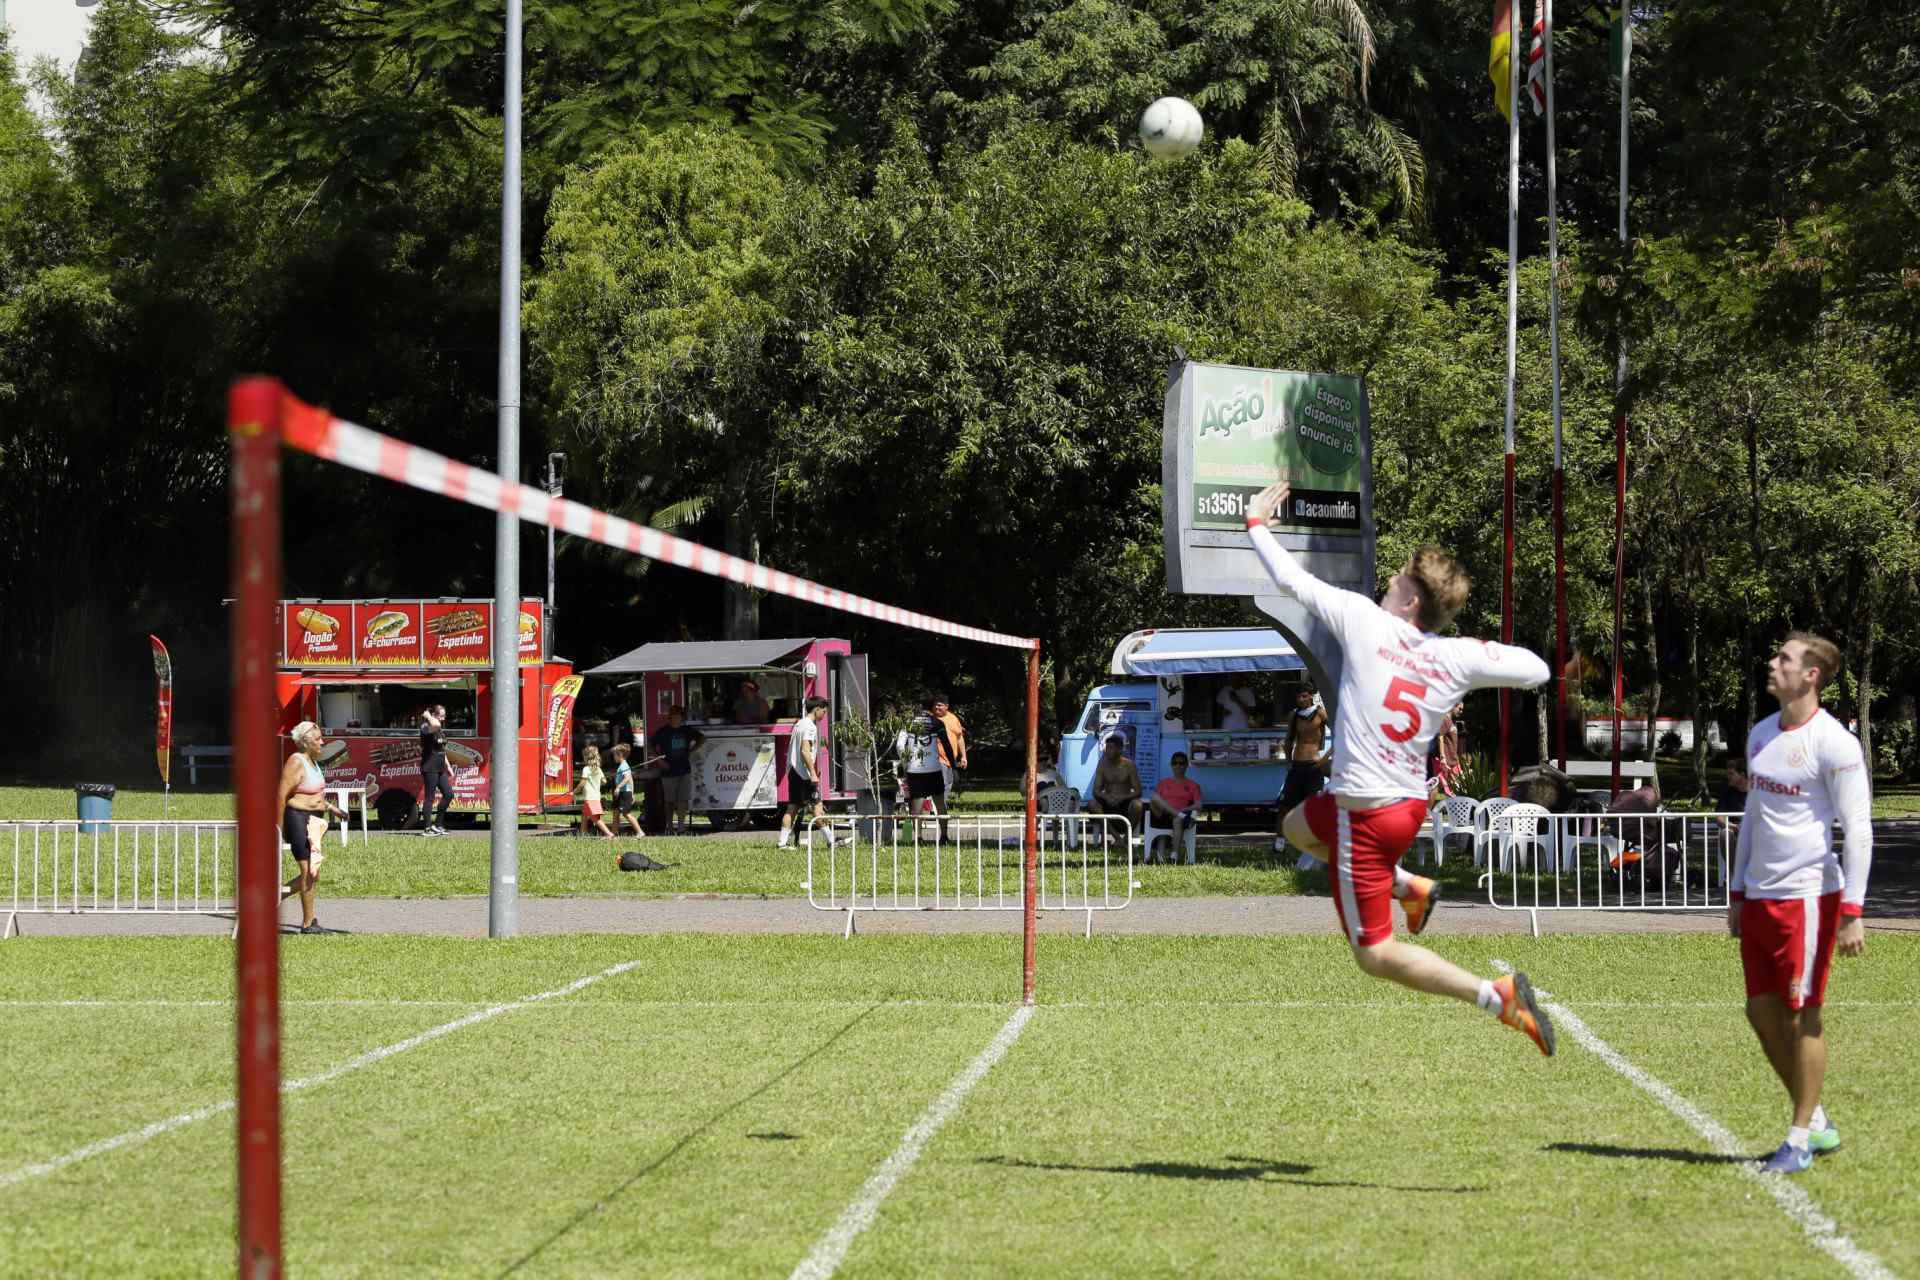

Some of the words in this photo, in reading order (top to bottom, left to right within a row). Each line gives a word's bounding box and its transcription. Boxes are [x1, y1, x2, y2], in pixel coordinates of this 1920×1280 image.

[1317, 388, 1352, 410] Espaço
[1200, 391, 1265, 437] Ação
[1300, 425, 1341, 449] anuncie
[1306, 501, 1356, 519] acaomidia
[438, 632, 484, 648] Espetinho
[1380, 676, 1427, 744] 5
[380, 763, 421, 779] Espetinh
